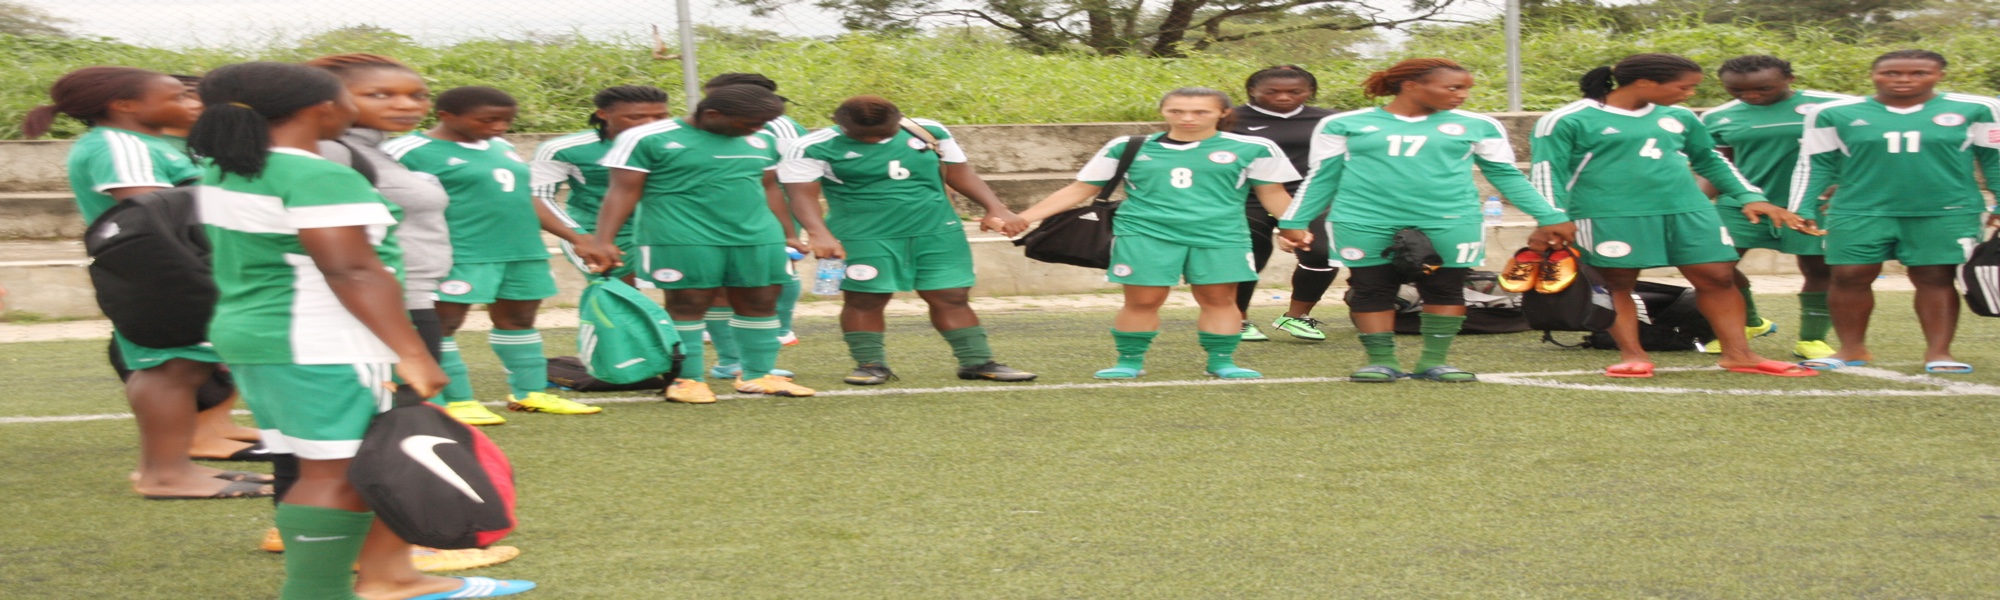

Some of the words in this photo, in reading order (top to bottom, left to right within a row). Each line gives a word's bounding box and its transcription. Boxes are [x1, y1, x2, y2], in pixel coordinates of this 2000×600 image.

[1386, 134, 1427, 157] 17
[1639, 138, 1662, 159] 4
[1883, 131, 1921, 153] 11
[492, 168, 515, 192] 9
[888, 160, 911, 180] 6
[1170, 166, 1193, 188] 8
[1456, 241, 1481, 263] 17
